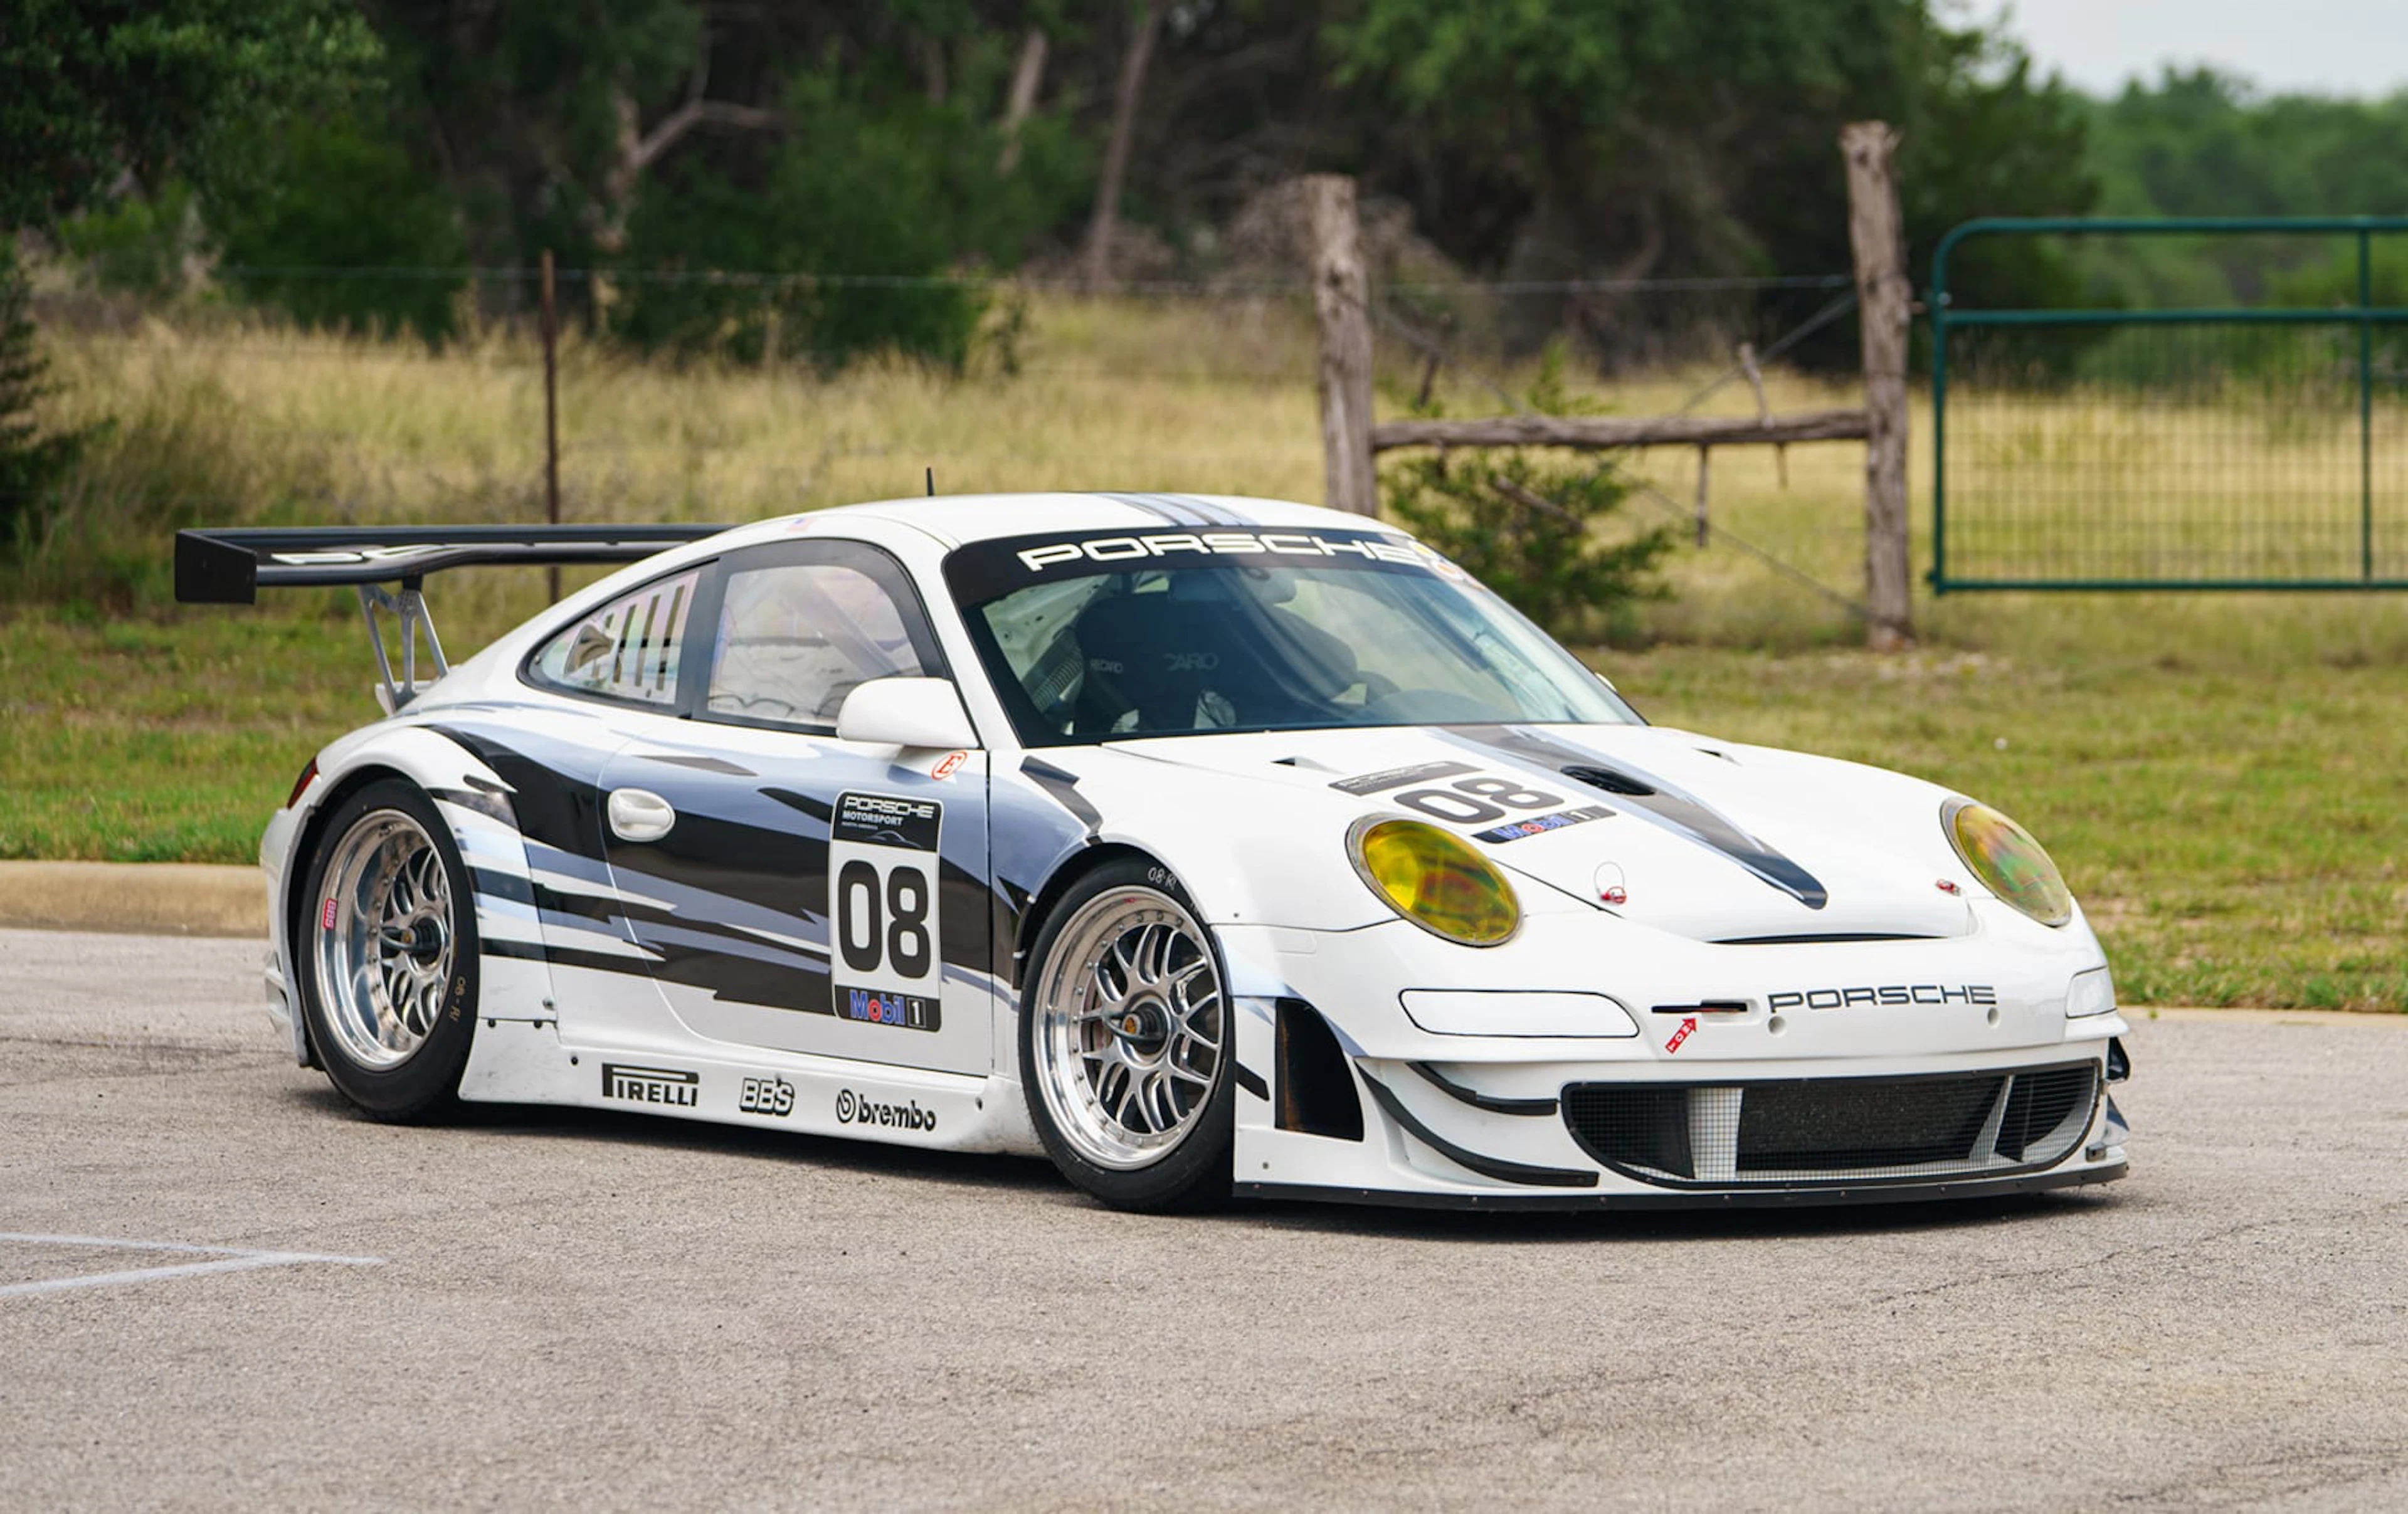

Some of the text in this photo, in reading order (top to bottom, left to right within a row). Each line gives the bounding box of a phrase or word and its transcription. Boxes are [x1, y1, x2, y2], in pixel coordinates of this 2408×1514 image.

[1017, 534, 1428, 572] PORSCHE
[842, 811, 904, 826] MOTORSPORT
[844, 796, 935, 819] PORSCHE
[1393, 777, 1565, 824] 08
[838, 860, 931, 979] 08
[849, 989, 921, 1026] Mobil 1
[1767, 985, 1997, 1014] PORSCHE
[602, 1062, 699, 1107] PIRELLI
[739, 1076, 795, 1117] BBS
[858, 1093, 937, 1132] brembo
